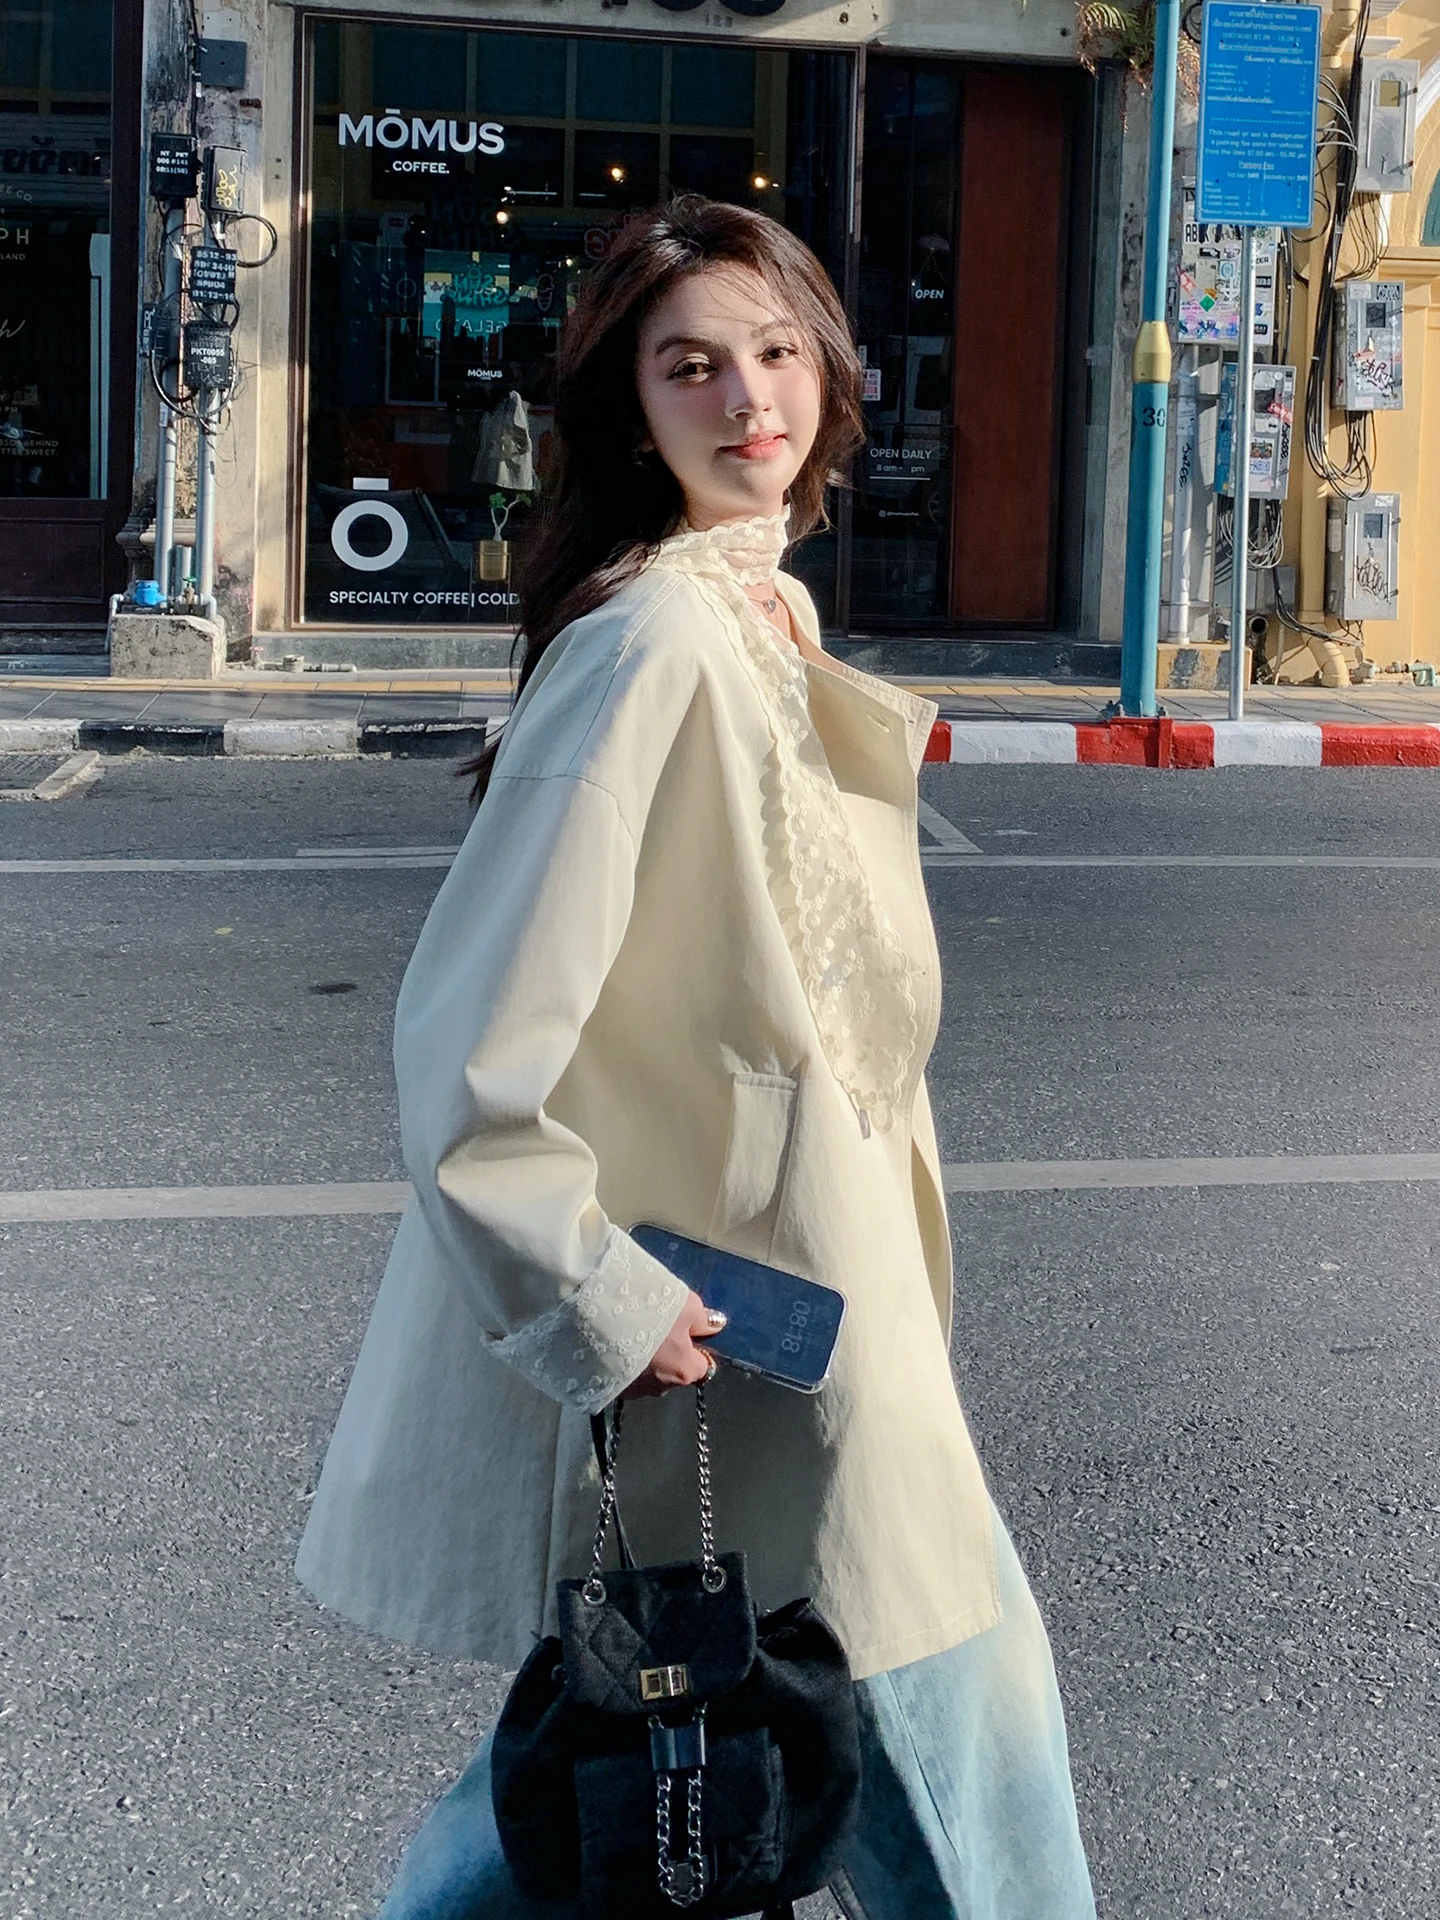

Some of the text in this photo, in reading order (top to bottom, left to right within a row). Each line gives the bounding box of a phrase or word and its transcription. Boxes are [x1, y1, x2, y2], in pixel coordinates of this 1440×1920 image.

[391, 160, 450, 174] COFFEE.
[914, 288, 945, 300] OPEN
[1142, 406, 1166, 428] 30
[869, 447, 932, 461] OPEN DAILY
[911, 466, 925, 474] pm
[329, 590, 409, 605] SPECIALTY
[413, 591, 469, 606] COFFEE
[781, 1300, 811, 1354] 08:18
